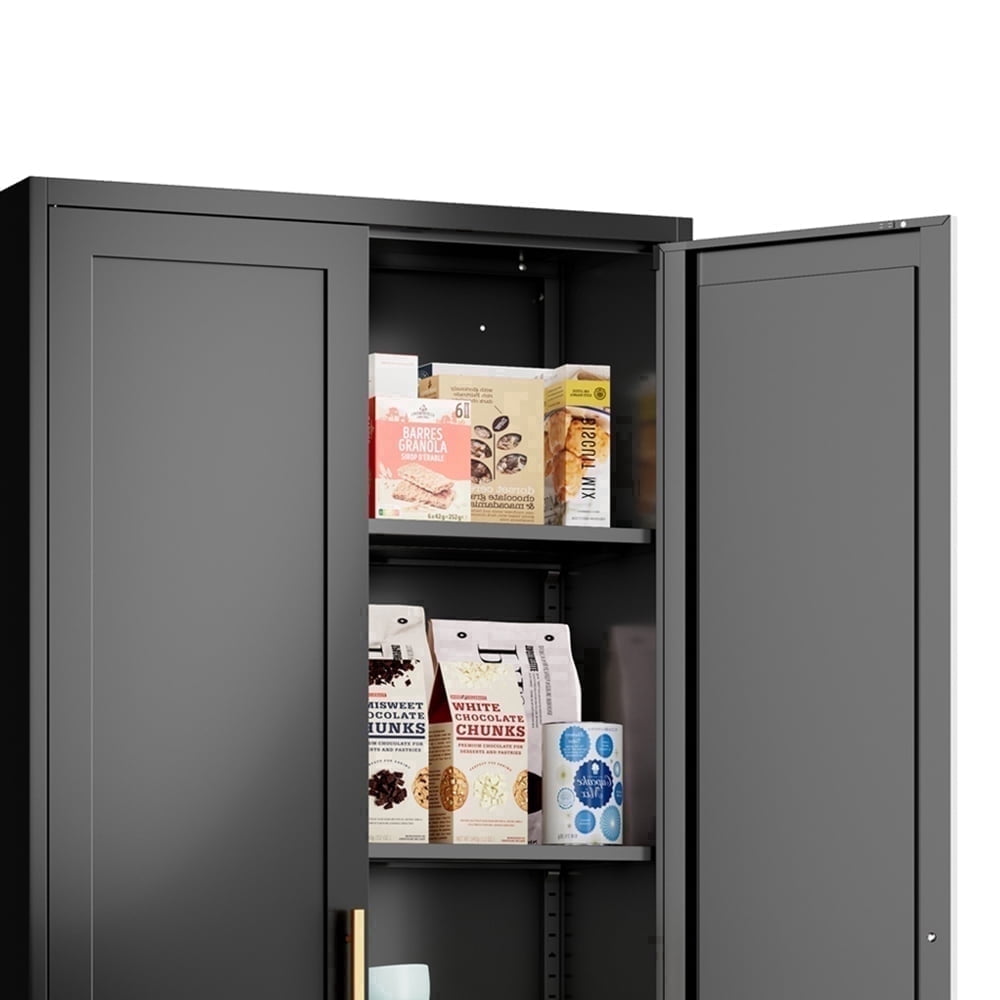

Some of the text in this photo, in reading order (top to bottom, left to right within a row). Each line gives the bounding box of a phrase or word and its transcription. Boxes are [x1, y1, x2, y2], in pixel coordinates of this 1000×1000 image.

[455, 402, 463, 418] 6
[403, 426, 443, 441] BARRES
[398, 438, 448, 453] GRANOLA
[452, 702, 501, 712] WHITE
[455, 713, 525, 723] CHOCOLATE
[456, 724, 525, 737] CHUNKS
